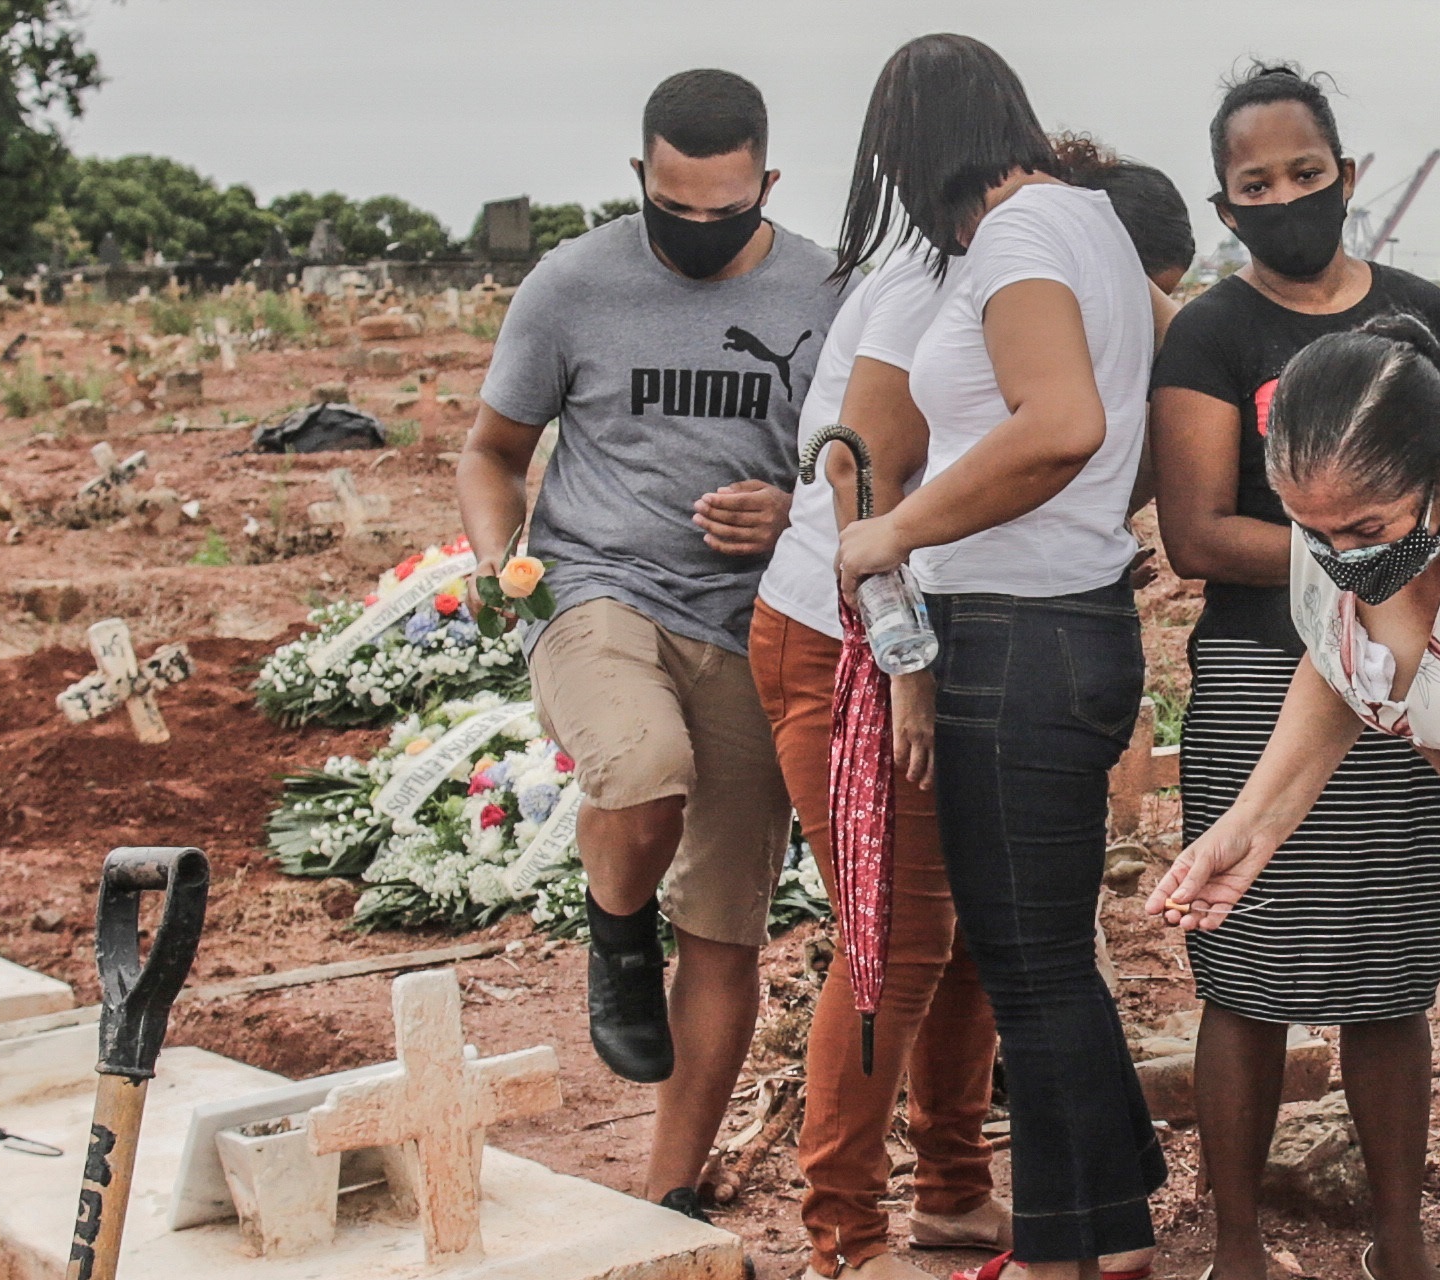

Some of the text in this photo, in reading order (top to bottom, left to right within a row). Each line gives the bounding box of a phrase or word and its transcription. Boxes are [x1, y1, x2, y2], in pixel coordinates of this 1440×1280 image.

[631, 368, 772, 420] PUMA
[435, 720, 490, 762] ESPOSA
[424, 756, 442, 774] E
[384, 764, 433, 816] FILHOS
[542, 837, 561, 853] E
